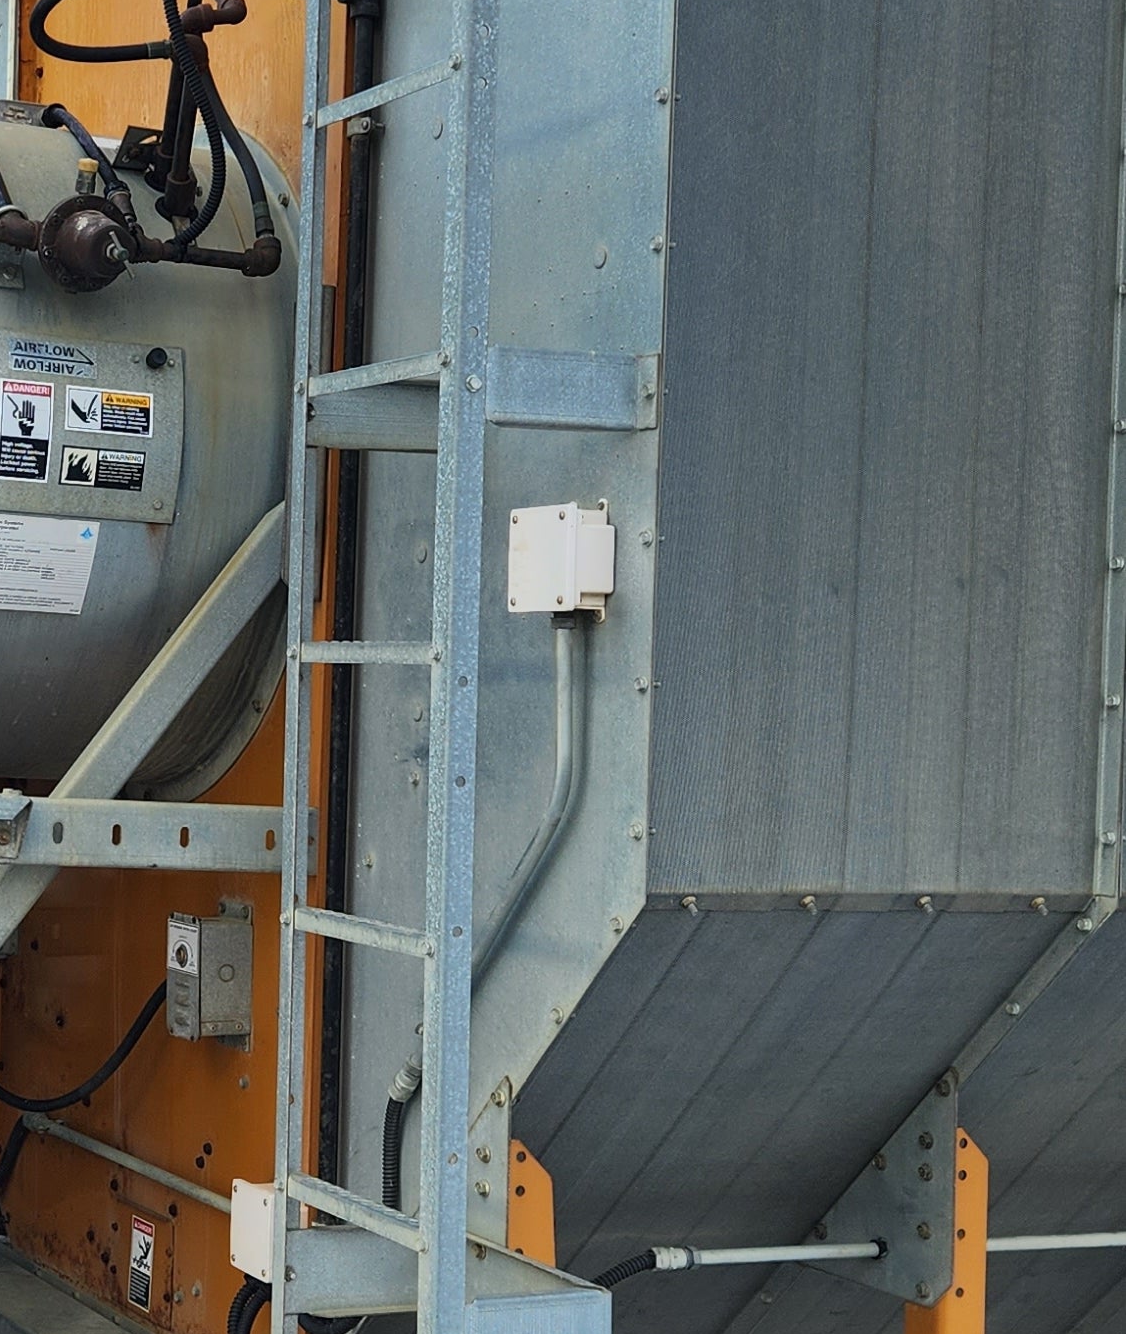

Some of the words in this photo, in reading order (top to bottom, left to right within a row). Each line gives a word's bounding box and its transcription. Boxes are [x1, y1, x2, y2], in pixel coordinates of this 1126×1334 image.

[14, 341, 75, 357] AIRFLOW
[14, 358, 75, 374] AIRFLOW
[12, 383, 50, 395] DANGER!
[115, 397, 148, 406] WARNING
[108, 454, 142, 463] WARNING
